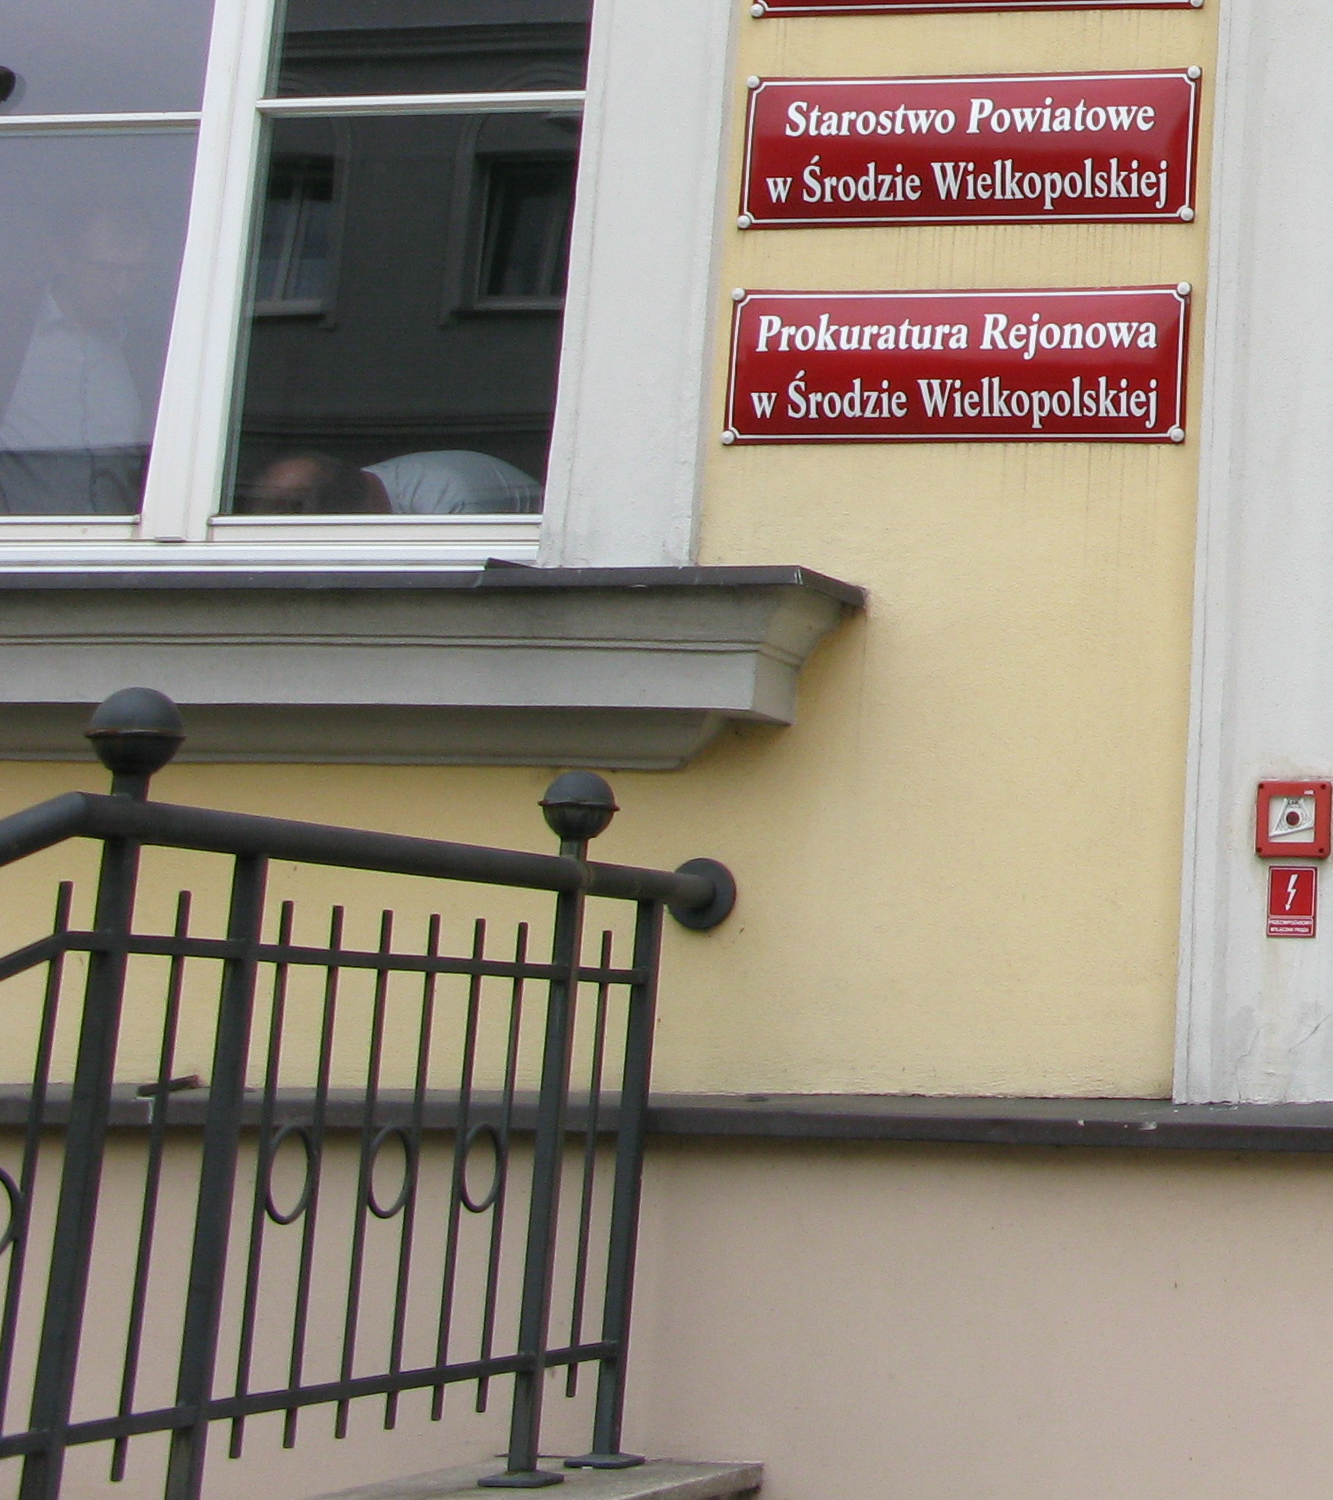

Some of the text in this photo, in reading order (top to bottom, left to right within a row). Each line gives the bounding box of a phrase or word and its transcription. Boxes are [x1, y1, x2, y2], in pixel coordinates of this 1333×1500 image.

[785, 96, 1155, 137] Starostwo Powiatowe
[765, 154, 1167, 210] w Środzie Wielkopolskiej
[755, 312, 1158, 361] Prokuratura Rejonowa
[750, 369, 1157, 429] w Środzie Wielkopolskiej
